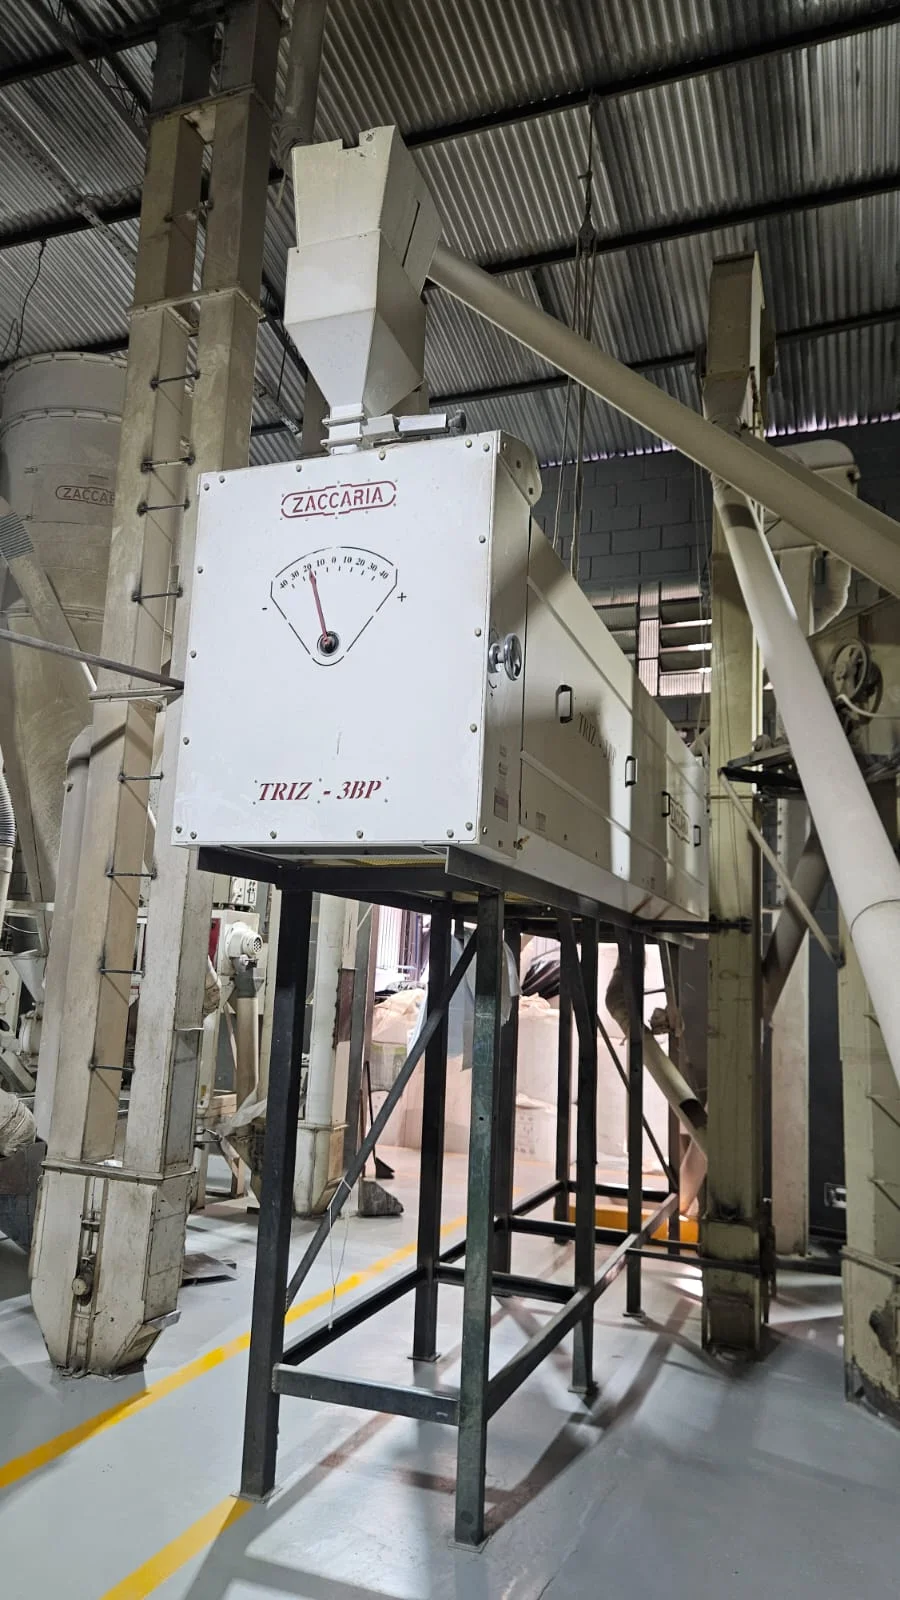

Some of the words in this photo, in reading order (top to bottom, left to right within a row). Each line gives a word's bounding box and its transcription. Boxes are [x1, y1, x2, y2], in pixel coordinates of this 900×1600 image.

[292, 487, 383, 513] ZACCARIA
[280, 579, 289, 589] 40
[291, 570, 300, 580] 30
[303, 563, 312, 573] 20
[316, 558, 325, 567] 10
[331, 556, 337, 564] 0
[343, 555, 352, 564] 10
[355, 557, 365, 567] 20
[368, 562, 378, 572] 30
[379, 570, 389, 580] 40
[259, 781, 313, 801] TRIZ
[336, 780, 382, 800] 3BP
